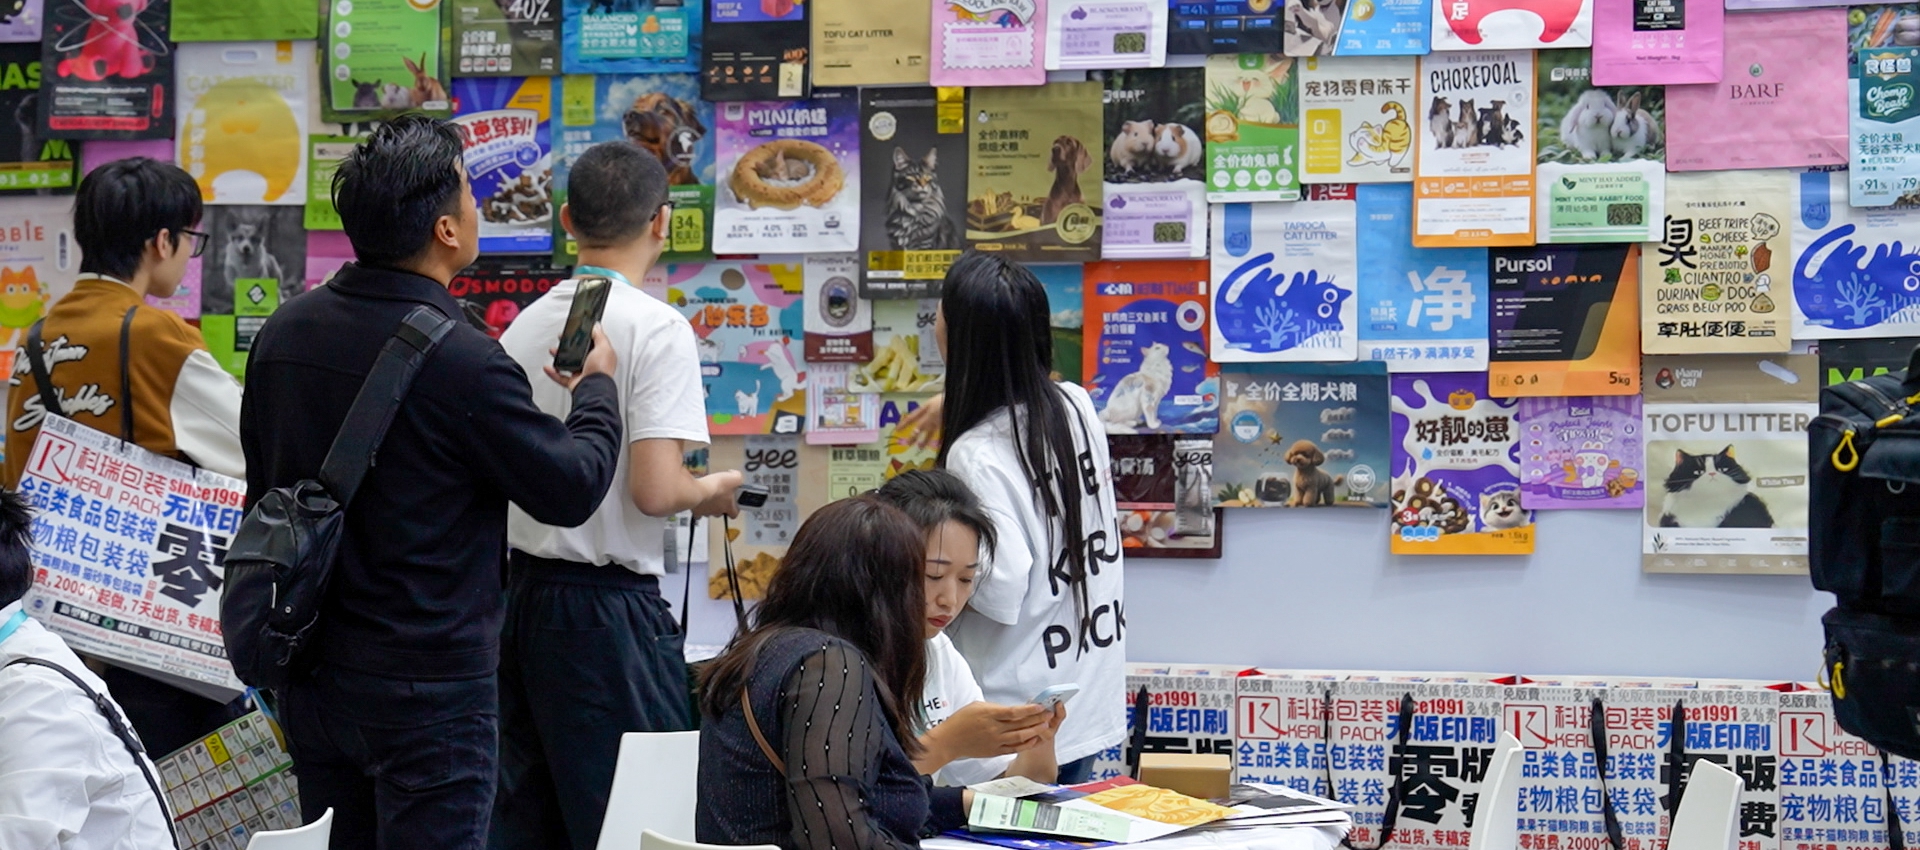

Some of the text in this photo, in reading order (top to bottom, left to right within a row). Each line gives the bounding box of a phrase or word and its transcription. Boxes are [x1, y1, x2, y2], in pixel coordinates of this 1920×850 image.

[823, 29, 893, 39] TOFU CAT LITTER
[1865, 58, 1912, 74] 食怪兽
[786, 71, 794, 82] 2
[1430, 62, 1521, 93] CHOREDOAL
[1305, 78, 1411, 97] 宠物零食冻干
[1730, 83, 1784, 99] BARF
[1866, 86, 1908, 103] Chomp
[1859, 133, 1903, 143] 全价犬粮
[1213, 153, 1279, 168] 全价幼兔粮
[1284, 221, 1326, 231] TAPIOCA
[1698, 218, 1749, 231] BEEF TRIPE
[1284, 231, 1337, 241] CAT LITTER
[1658, 214, 1697, 269] 臭
[1713, 232, 1749, 243] CHEESE
[1495, 255, 1552, 273] Pursol
[1700, 252, 1733, 260] HONEY
[1684, 272, 1741, 285] CILANTRO
[1406, 266, 1476, 331] 净
[1657, 286, 1756, 301] DURIAN DOG
[1657, 302, 1747, 314] GRASS BELLY POO
[1881, 307, 1920, 324] Have
[1307, 319, 1342, 336] Purr
[1295, 332, 1342, 348] Haven
[1371, 347, 1422, 360] 自然干净
[1608, 371, 1631, 386] 5kg
[1675, 368, 1702, 380] Mami
[1245, 382, 1357, 401] 全价全期犬粮
[1415, 416, 1510, 446] 好靓的崽
[1647, 412, 1810, 433] TOFU LITTER
[745, 449, 797, 472] yee
[76, 446, 168, 499] 科瑞包装
[1760, 478, 1781, 486] White
[71, 474, 162, 518] KERUI PACK
[162, 494, 243, 535] 无版印
[31, 516, 150, 579] 物粮包装袋
[152, 523, 227, 609] 零
[186, 613, 224, 637] 专稿定
[161, 663, 229, 686] MADE IN CHINA
[1287, 697, 1384, 723] 科瑞包装
[1340, 725, 1384, 741] PACK
[1609, 735, 1655, 749] PACK
[1238, 741, 1384, 772] 全品类食品包装袋
[1522, 752, 1655, 780] 品类食品包装袋
[1736, 755, 1776, 792] 版
[1780, 758, 1920, 788] 全品类食品包装
[1388, 744, 1460, 825] 零
[1781, 792, 1920, 824] 宠物粮包装
[1740, 801, 1777, 838] 费
[1782, 828, 1869, 842] 坚果果干猫粮狗粮
